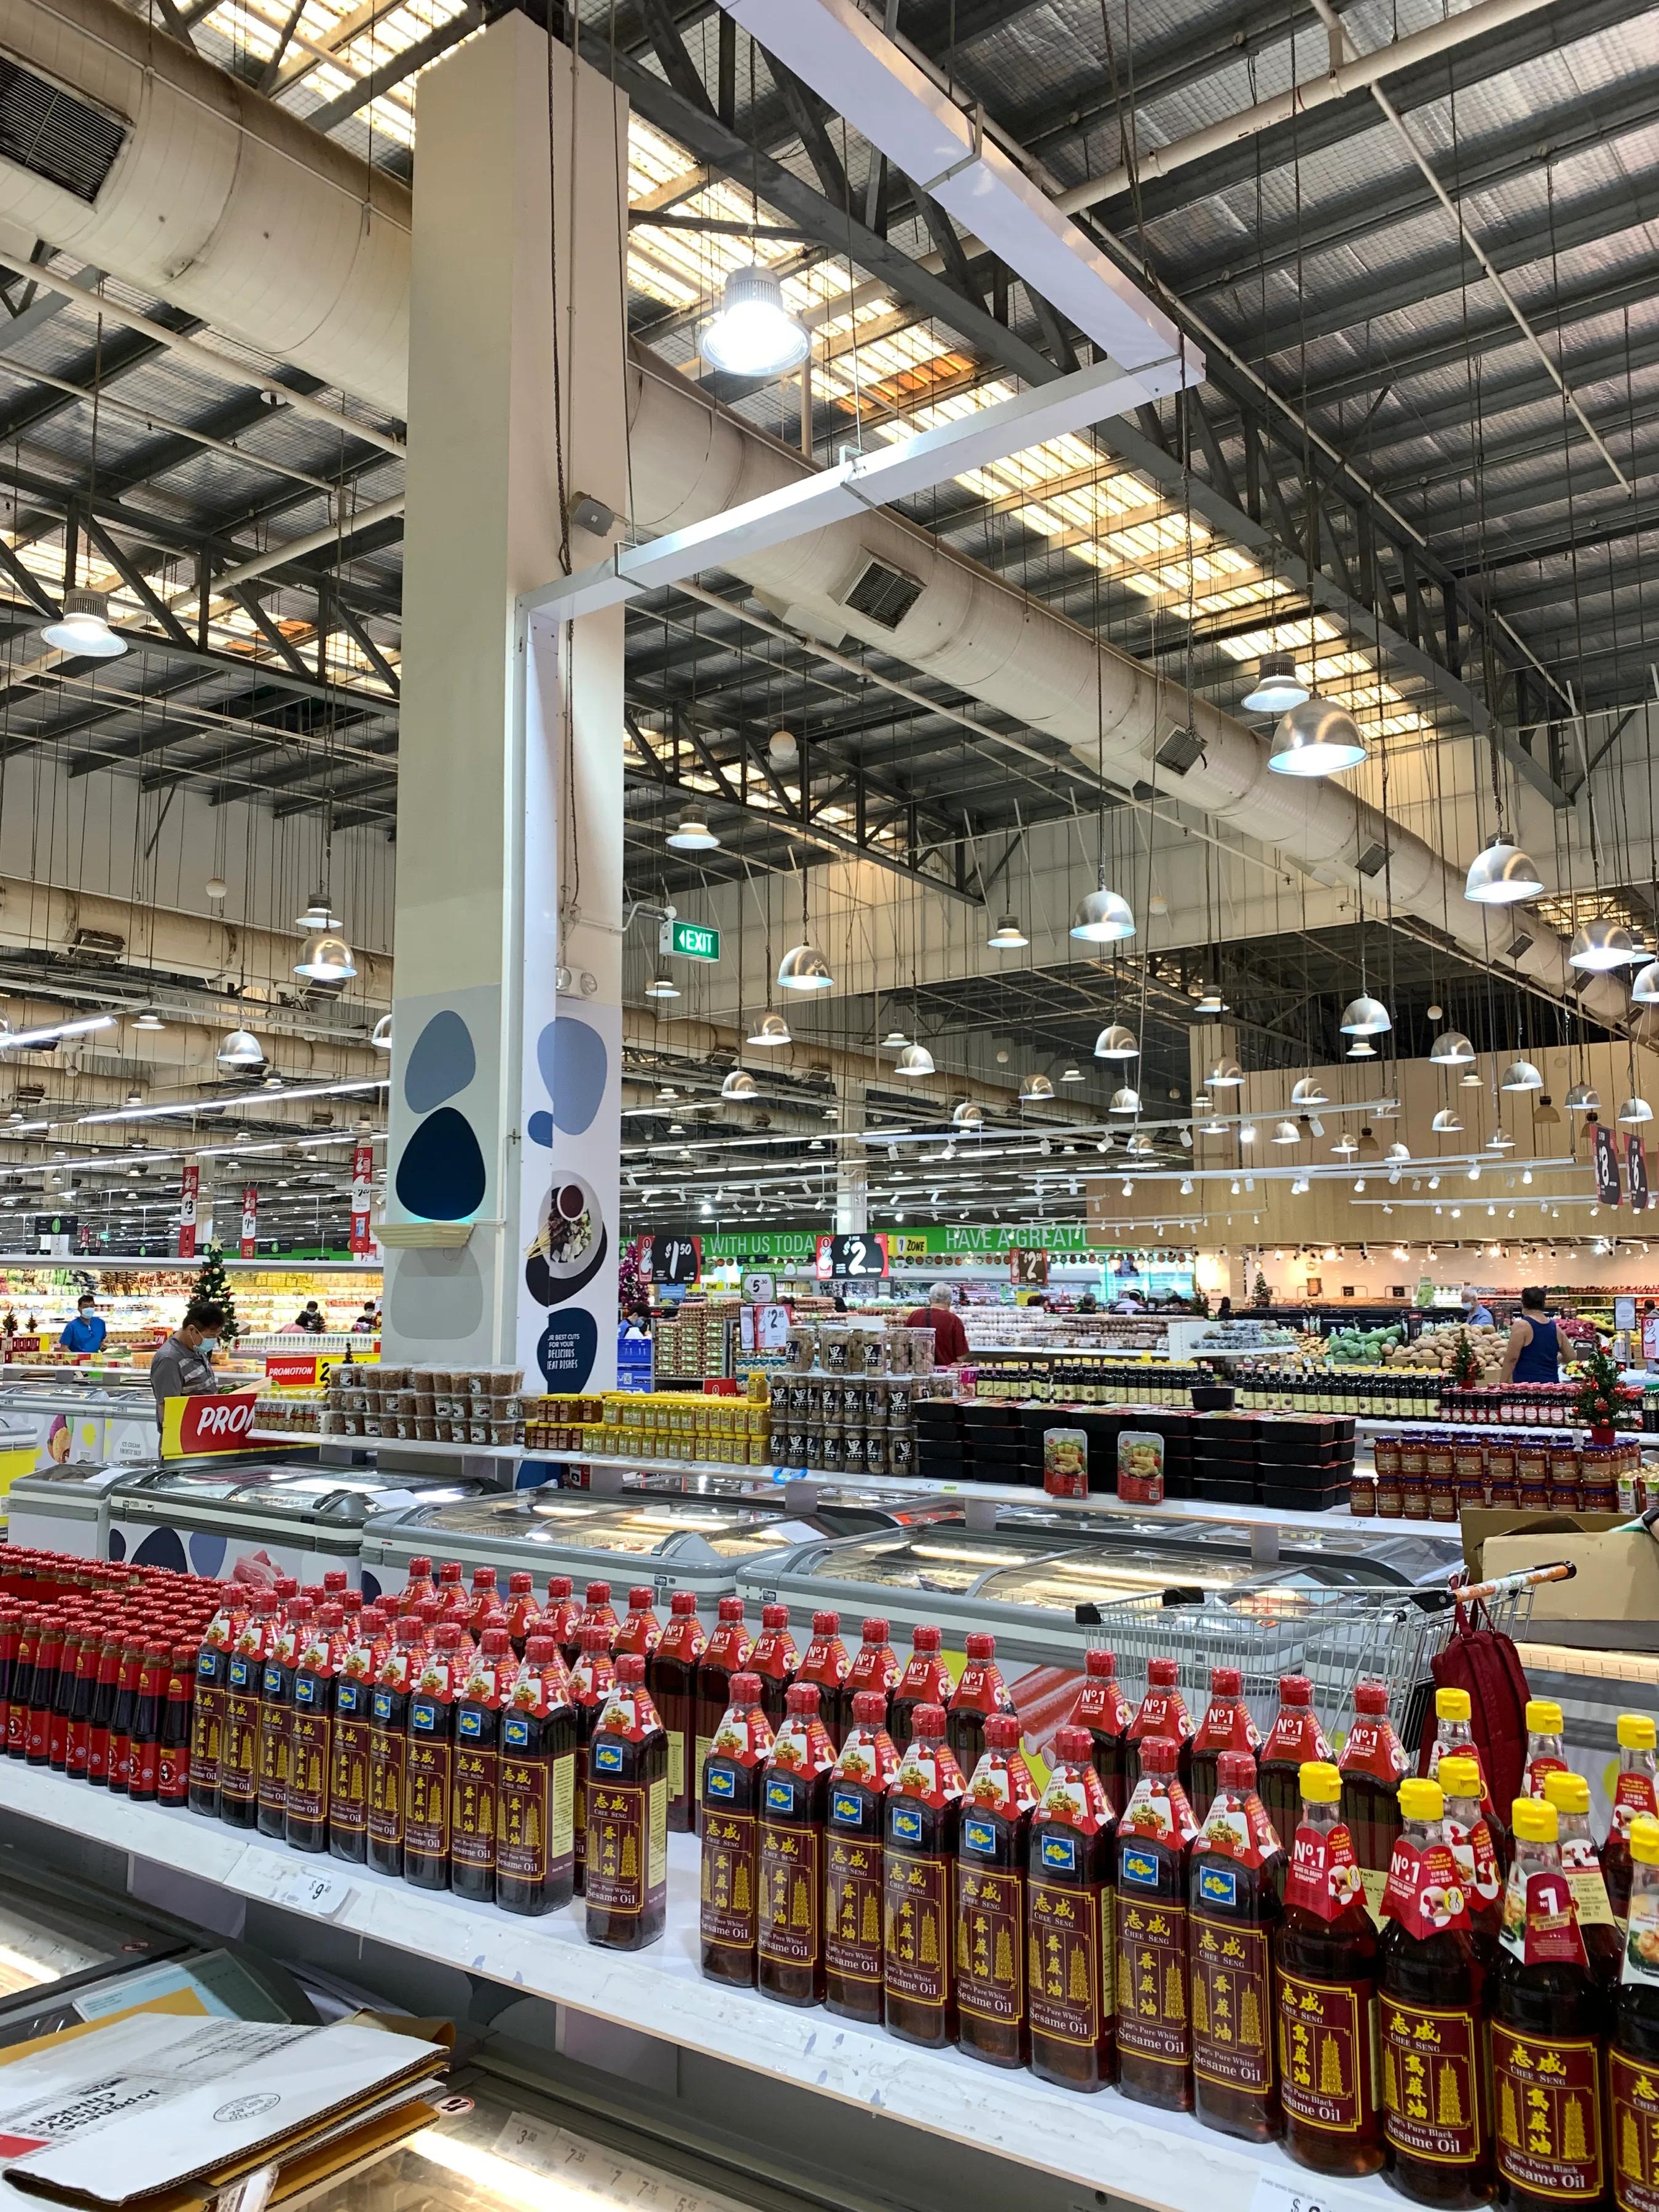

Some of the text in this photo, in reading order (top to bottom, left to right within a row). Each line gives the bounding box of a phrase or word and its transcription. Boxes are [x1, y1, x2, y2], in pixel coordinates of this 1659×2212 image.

[686, 930, 713, 952] EXIT
[710, 1237, 747, 1257] WITH
[751, 1236, 774, 1253] US
[778, 1235, 817, 1252] TODA
[907, 1240, 924, 1252] ZONE
[946, 1228, 1076, 1249] HAVE A GREAT
[843, 1242, 866, 1275] $2
[548, 1349, 575, 1359] DELICIOUS
[269, 1367, 313, 1377] PROMOTION
[547, 1360, 578, 1370] EAT DISHES
[350, 1814, 361, 1822] Oil
[428, 1839, 440, 1848] Oil
[477, 1847, 490, 1858] Oil
[524, 1861, 537, 1872] Oil
[831, 1863, 867, 1877] CHEE SENG
[587, 1887, 618, 1902] Sesame
[620, 1894, 635, 1904] Oil
[890, 1880, 925, 1895] CHEE SENG
[963, 1894, 1000, 1910] CHEE SENG
[1539, 1888, 1558, 1917] 1
[1034, 1912, 1073, 1928] CHEE SENG
[1125, 1929, 1169, 1945] CHEE SENG
[826, 1951, 877, 1972] Sesame Oil
[1200, 1950, 1244, 1968] CHEE SENG
[885, 1970, 936, 1994] Sesame Oil
[957, 1988, 1012, 2013] Sesame Oil
[973, 1986, 1006, 2001] Pure White
[1030, 2008, 1087, 2034] Sesame Oil
[1047, 2007, 1061, 2017] Pure
[1062, 2012, 1081, 2022] White
[1282, 2002, 1322, 2024] CHEE SENG
[1118, 2028, 1184, 2053] Sesame Oil
[1140, 2026, 1156, 2036] Pure
[1158, 2030, 1179, 2040] White
[1391, 2033, 1440, 2053] CHEE SENG
[1194, 2051, 1260, 2081] Sesame Oil
[1215, 2051, 1231, 2062] Pure
[1233, 2057, 1254, 2068] White
[1511, 2066, 1566, 2086] CHEE SENG
[1294, 2088, 1333, 2107] Pure Black
[31, 2092, 116, 2127] Chicken
[48, 2101, 115, 2130] Crispy
[62, 2089, 160, 2131] Japanese
[1319, 2108, 1340, 2122] Oil
[1388, 2120, 1460, 2152] Sesame Oil
[1408, 2122, 1426, 2135] Pure
[1429, 2128, 1453, 2139] Black
[1505, 2156, 1585, 2188] Sesame Oil
[1529, 2158, 1550, 2171] Pure
[1553, 2164, 1577, 2174] Black
